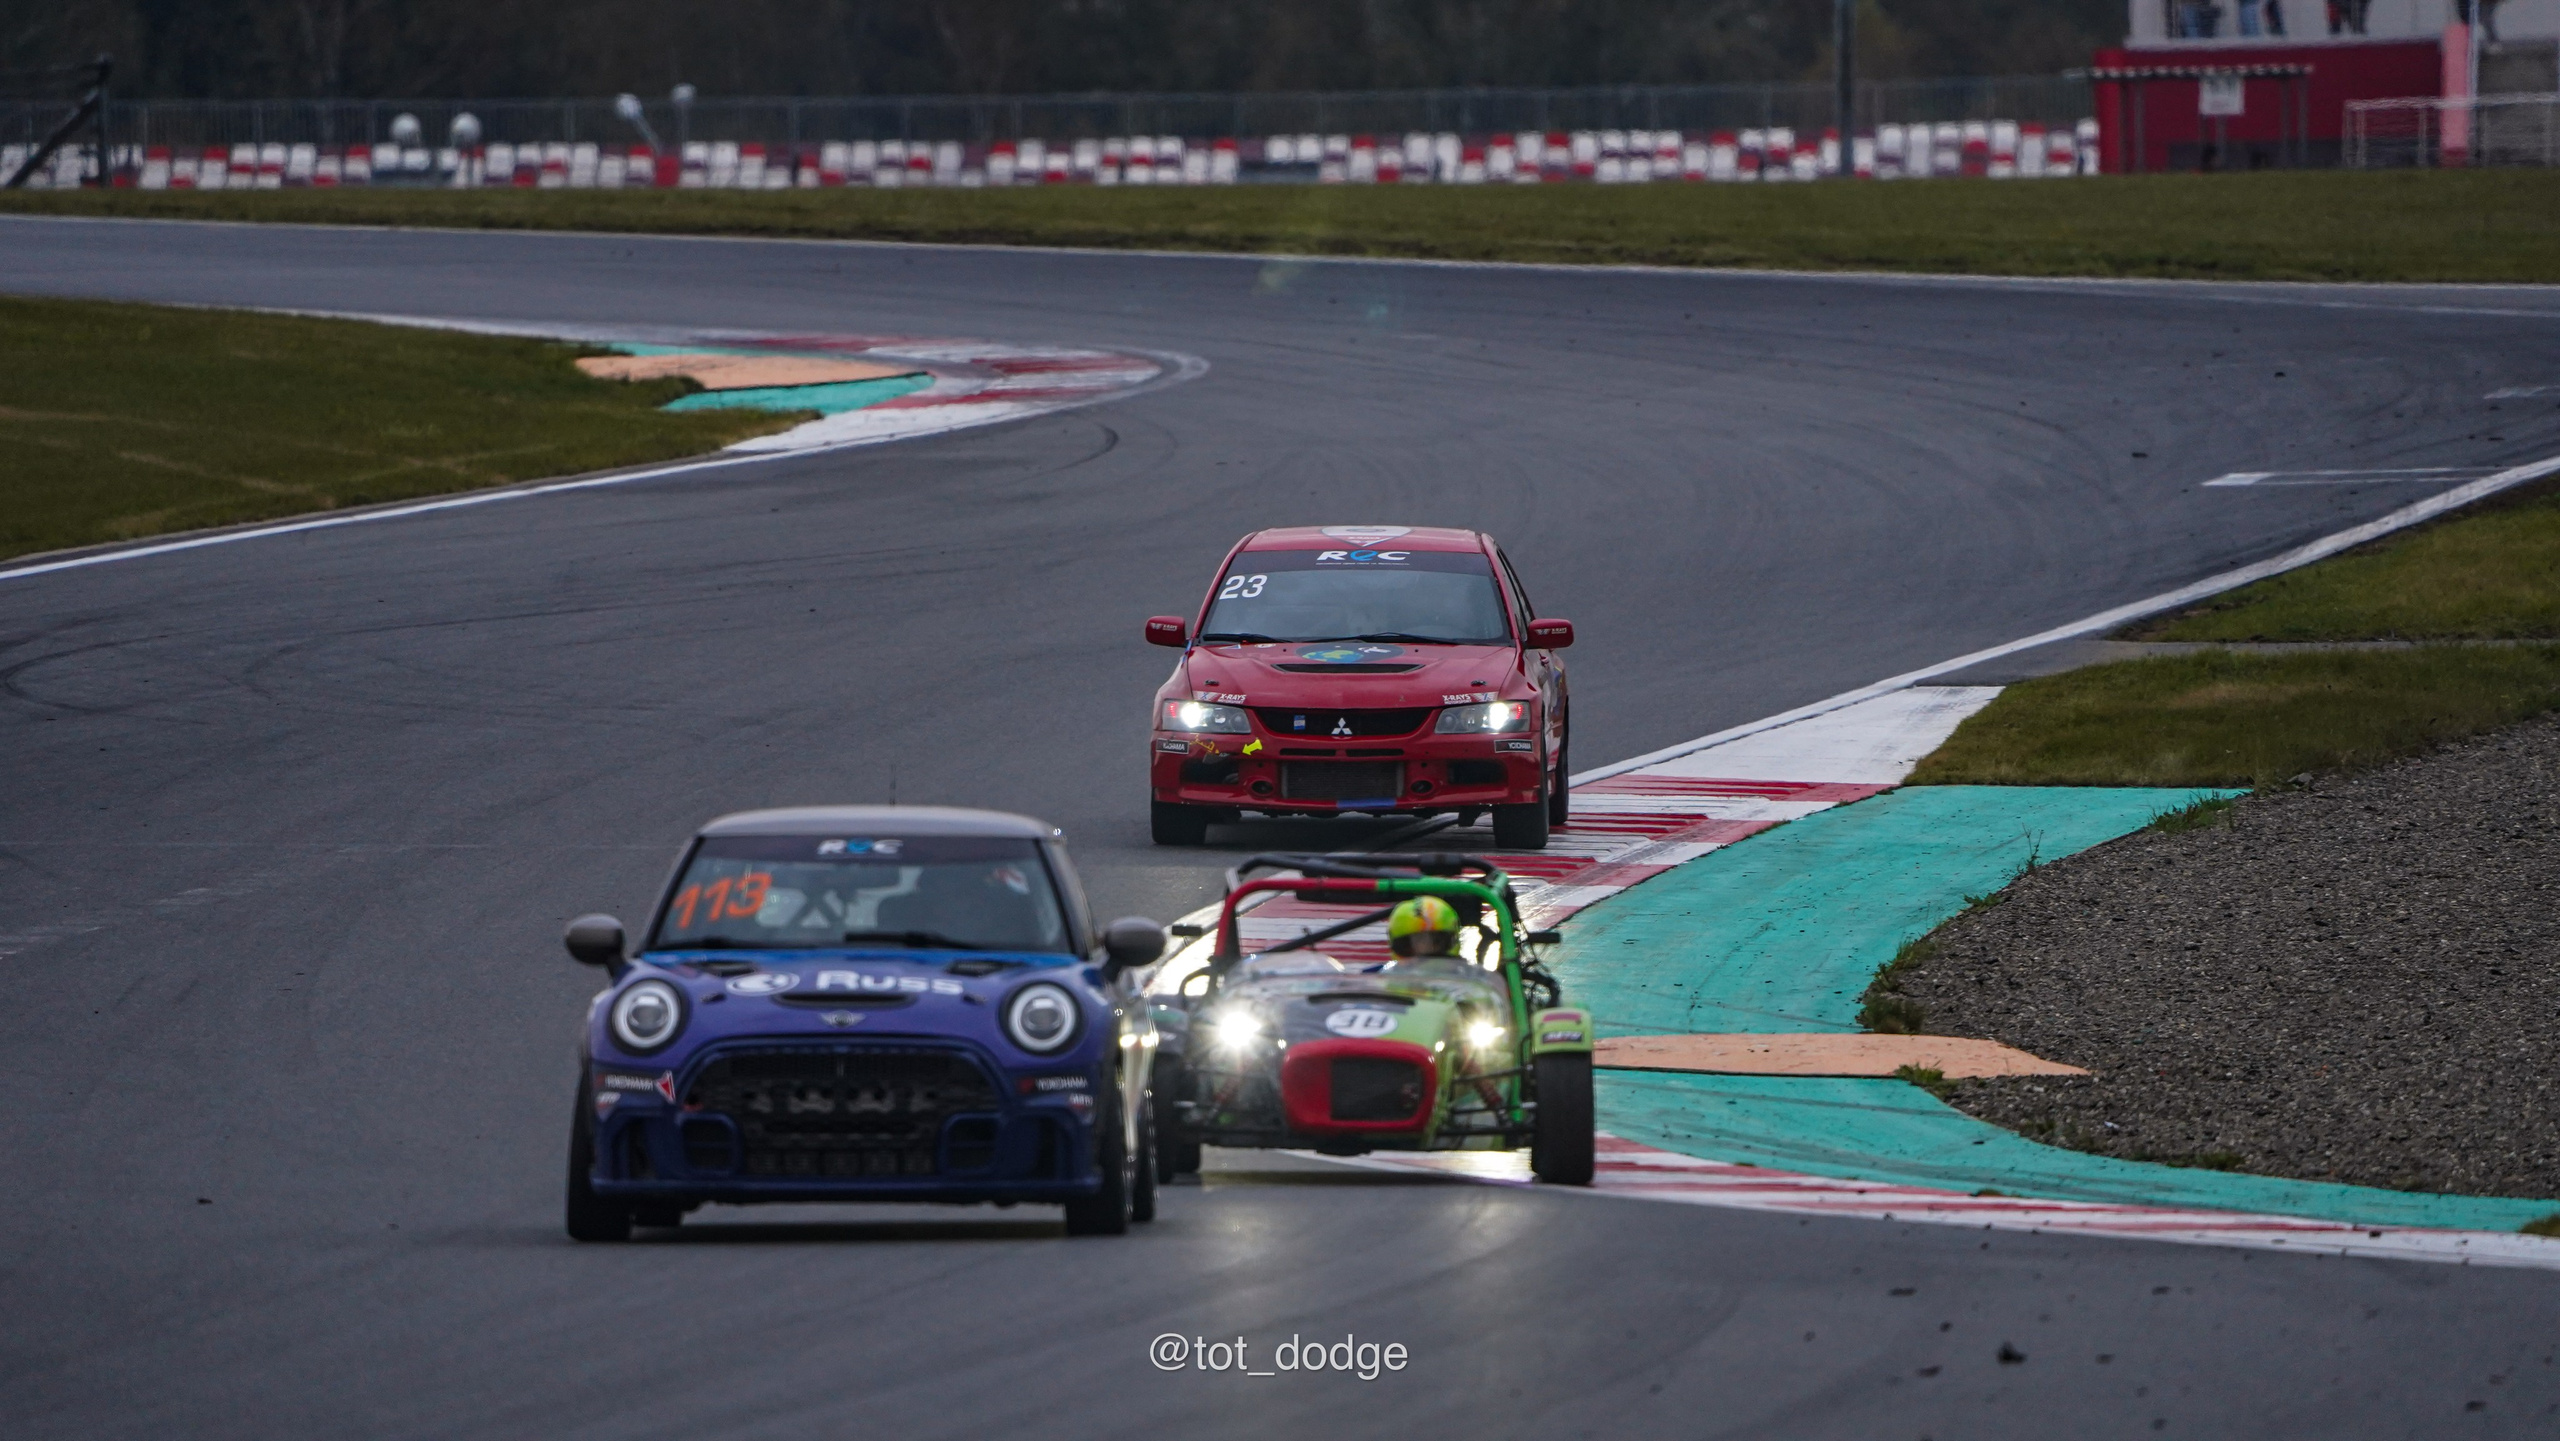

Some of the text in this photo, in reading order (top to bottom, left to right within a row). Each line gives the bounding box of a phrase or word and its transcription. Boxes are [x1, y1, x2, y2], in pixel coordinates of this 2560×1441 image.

[1219, 574, 1268, 600] 23
[1220, 693, 1247, 701] X-RAYS
[673, 871, 773, 930] 113
